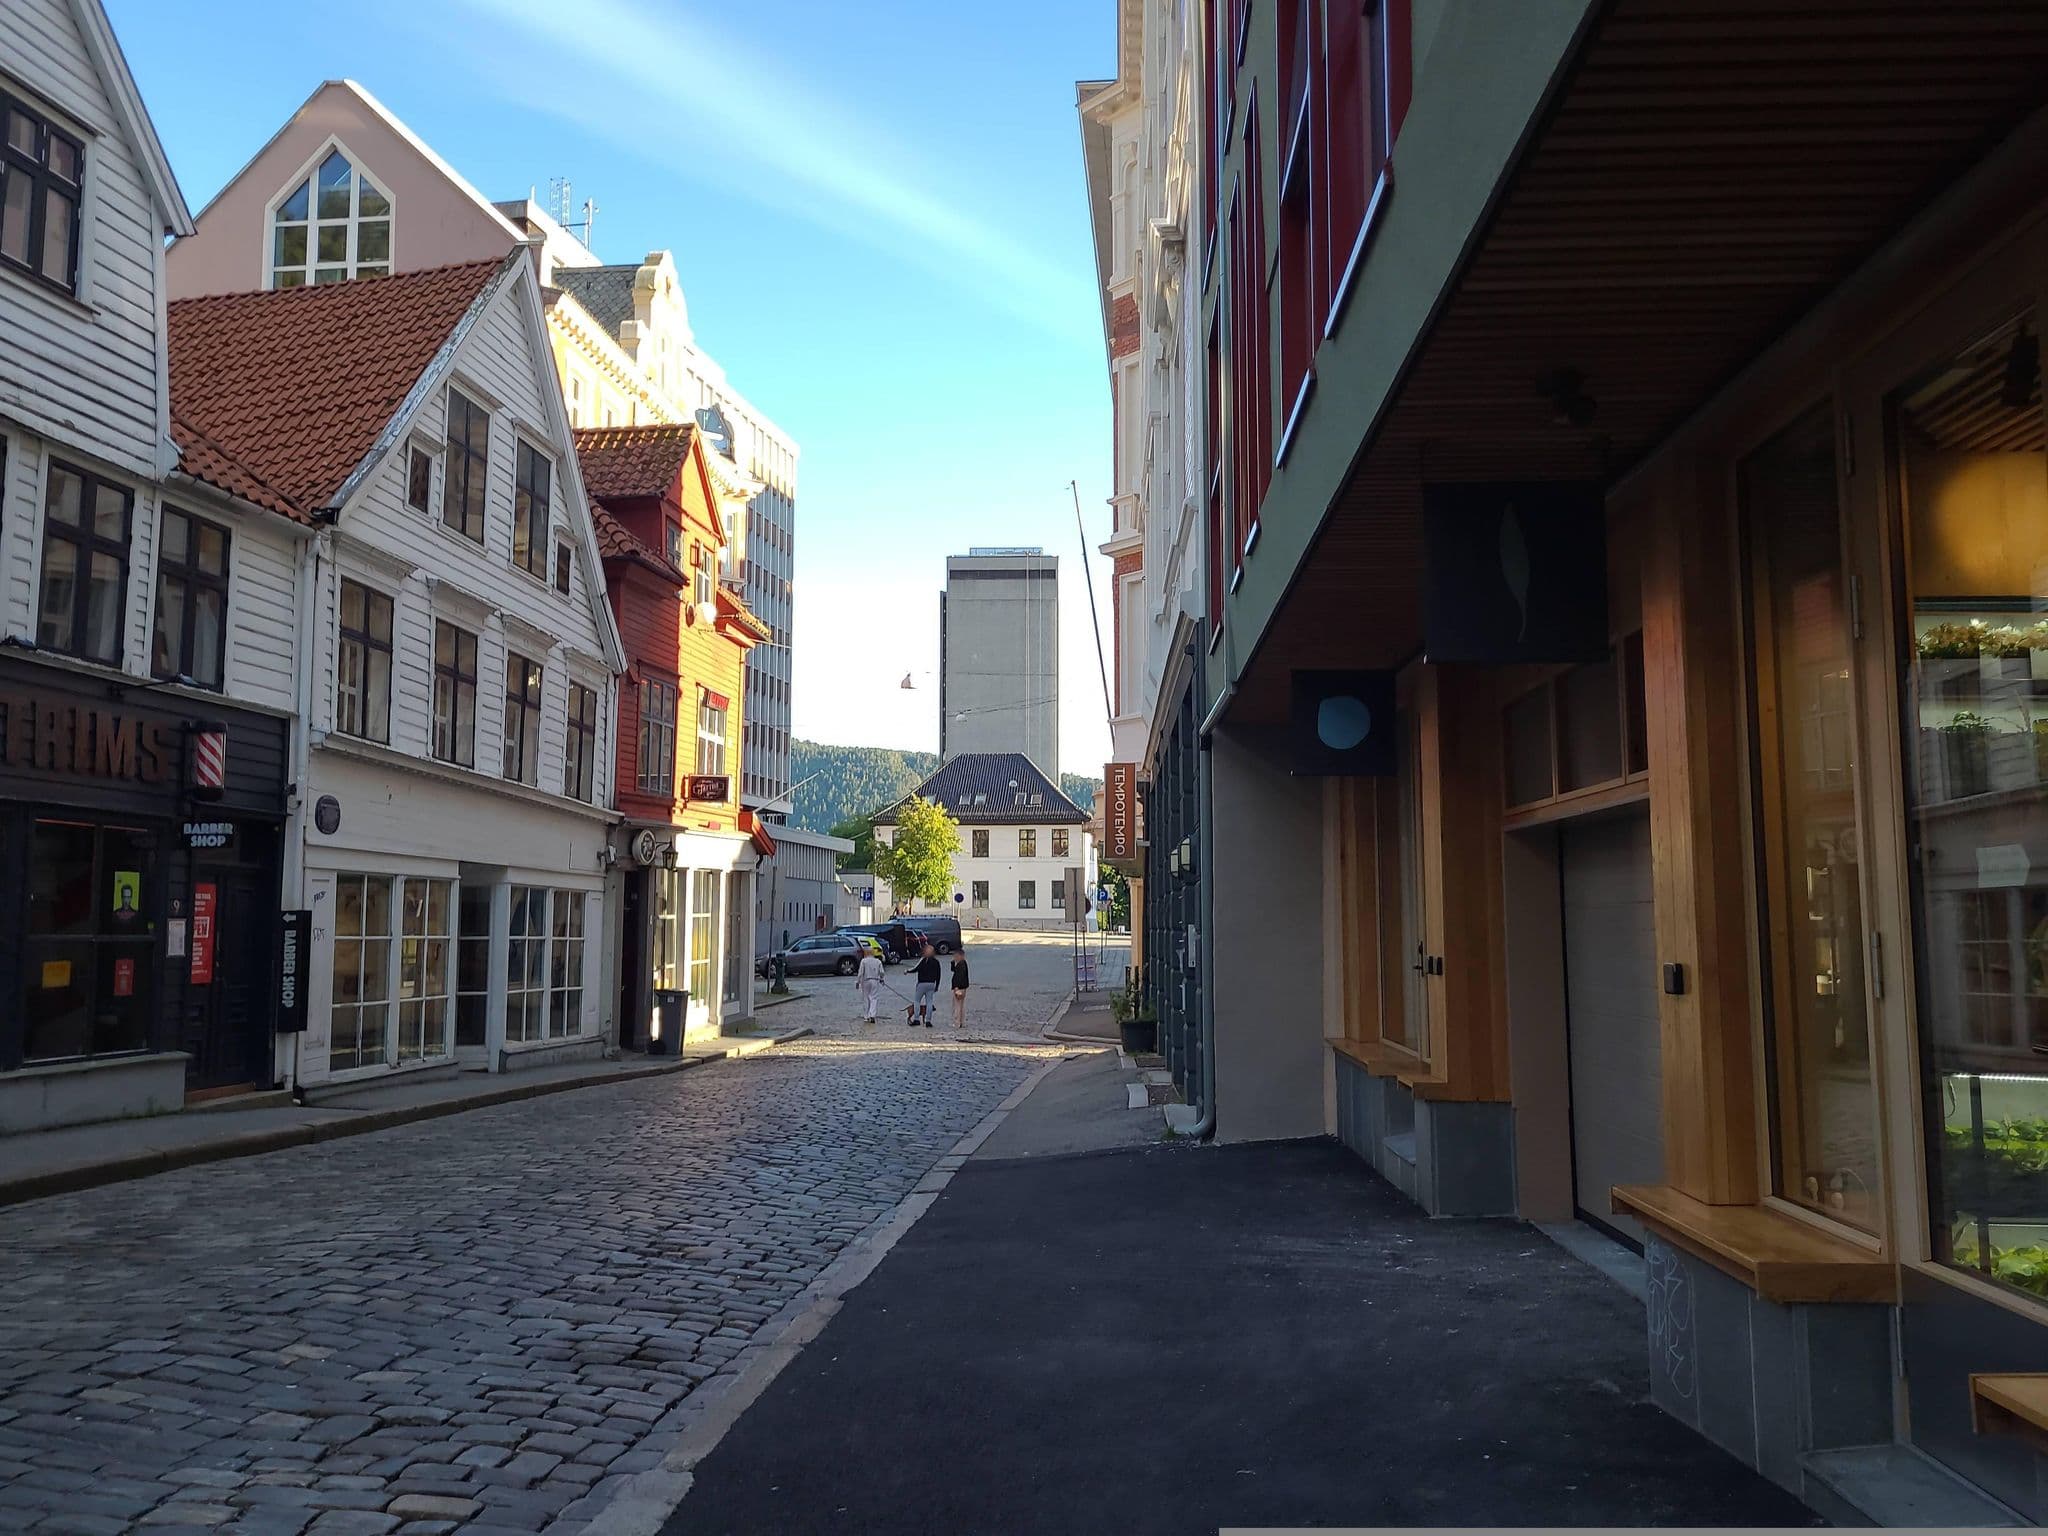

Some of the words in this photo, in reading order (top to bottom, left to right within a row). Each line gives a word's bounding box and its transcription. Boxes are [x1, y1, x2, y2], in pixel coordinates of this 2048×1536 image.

[1114, 767, 1126, 856] TEMPOTEMPO
[183, 822, 234, 835] BARBER
[190, 835, 226, 847] SHOP
[283, 930, 297, 975] BARBER
[282, 976, 296, 1008] SHOP
